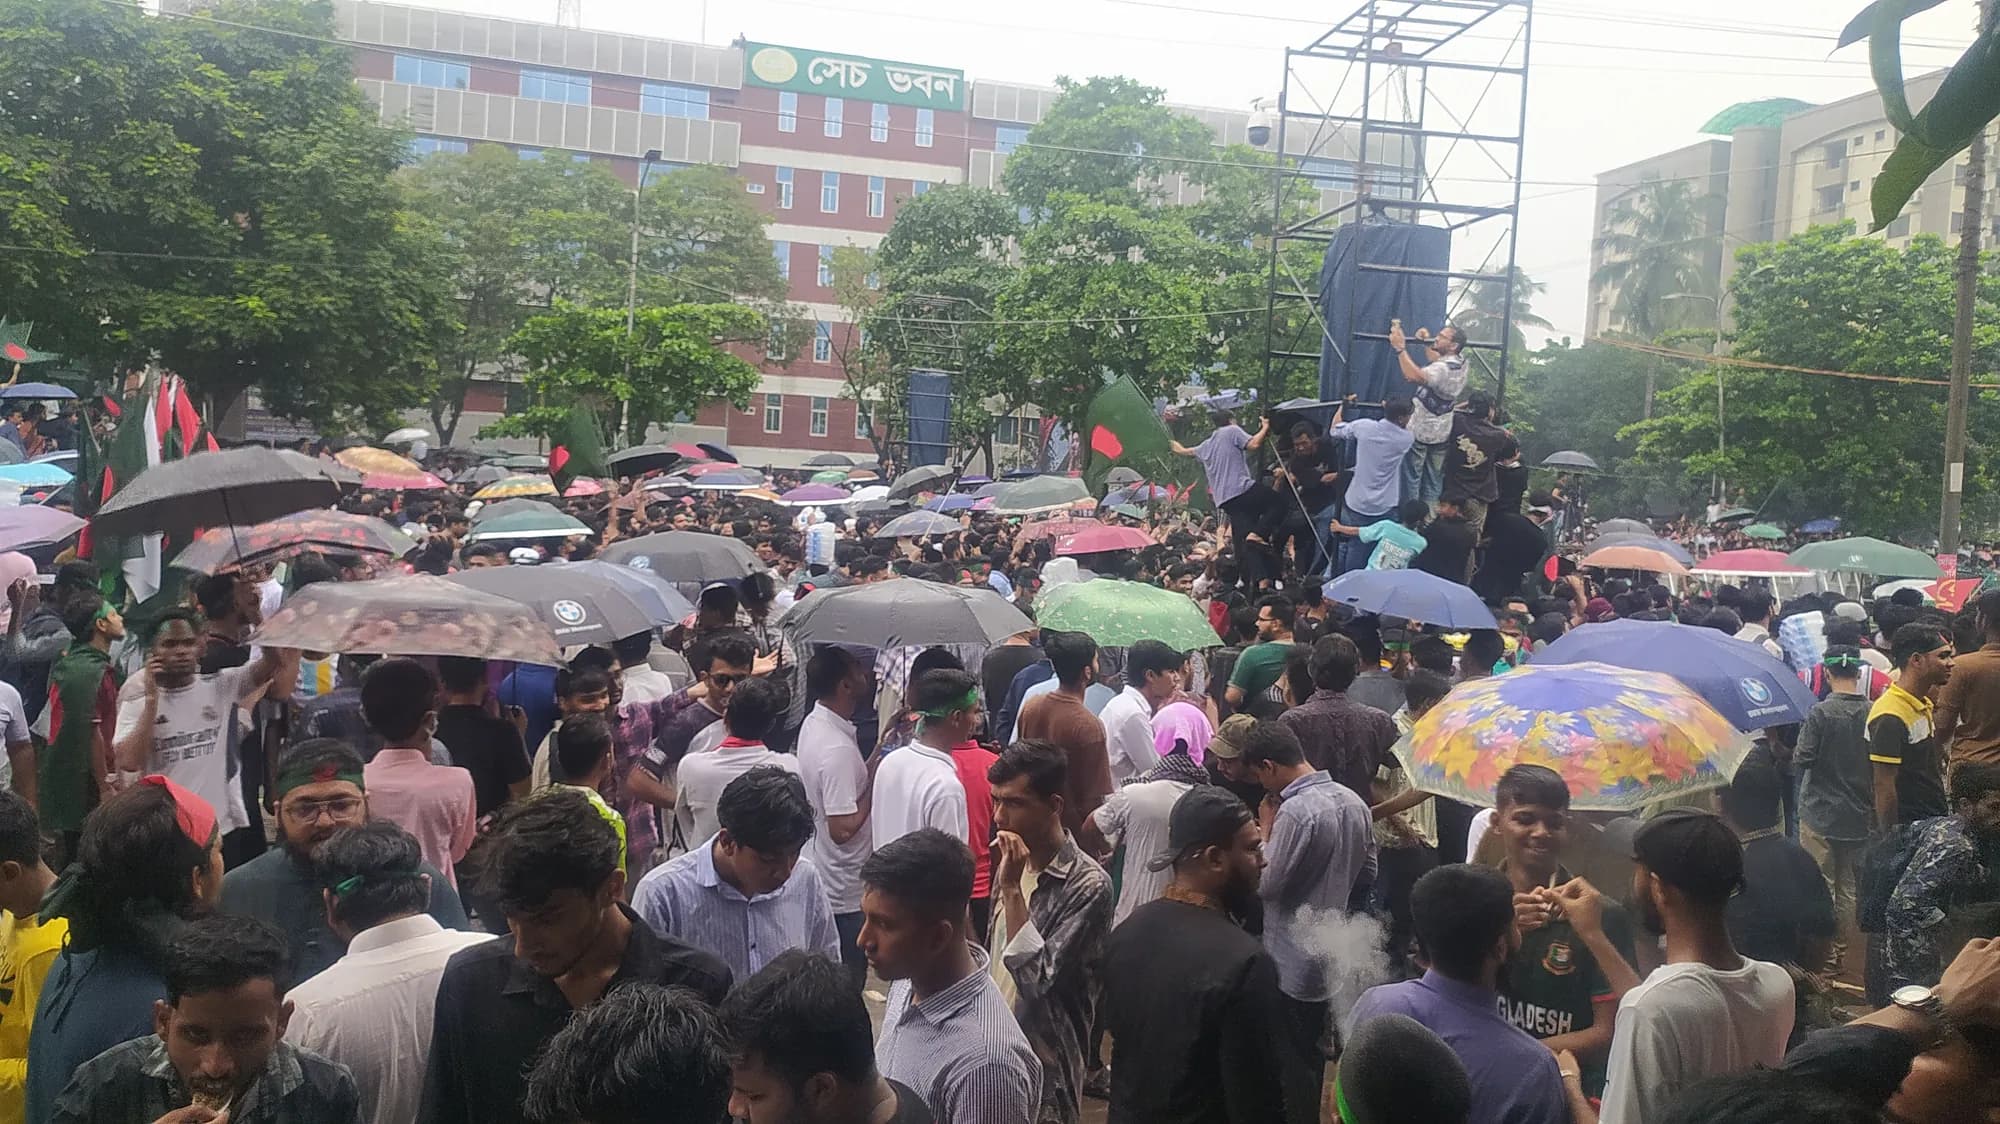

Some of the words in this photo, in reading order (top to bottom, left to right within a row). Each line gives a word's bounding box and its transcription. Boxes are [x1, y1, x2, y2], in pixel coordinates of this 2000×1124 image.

[808, 57, 872, 88] সেচ
[883, 66, 960, 102] ভবন
[1496, 995, 1573, 1035] GLADESH
